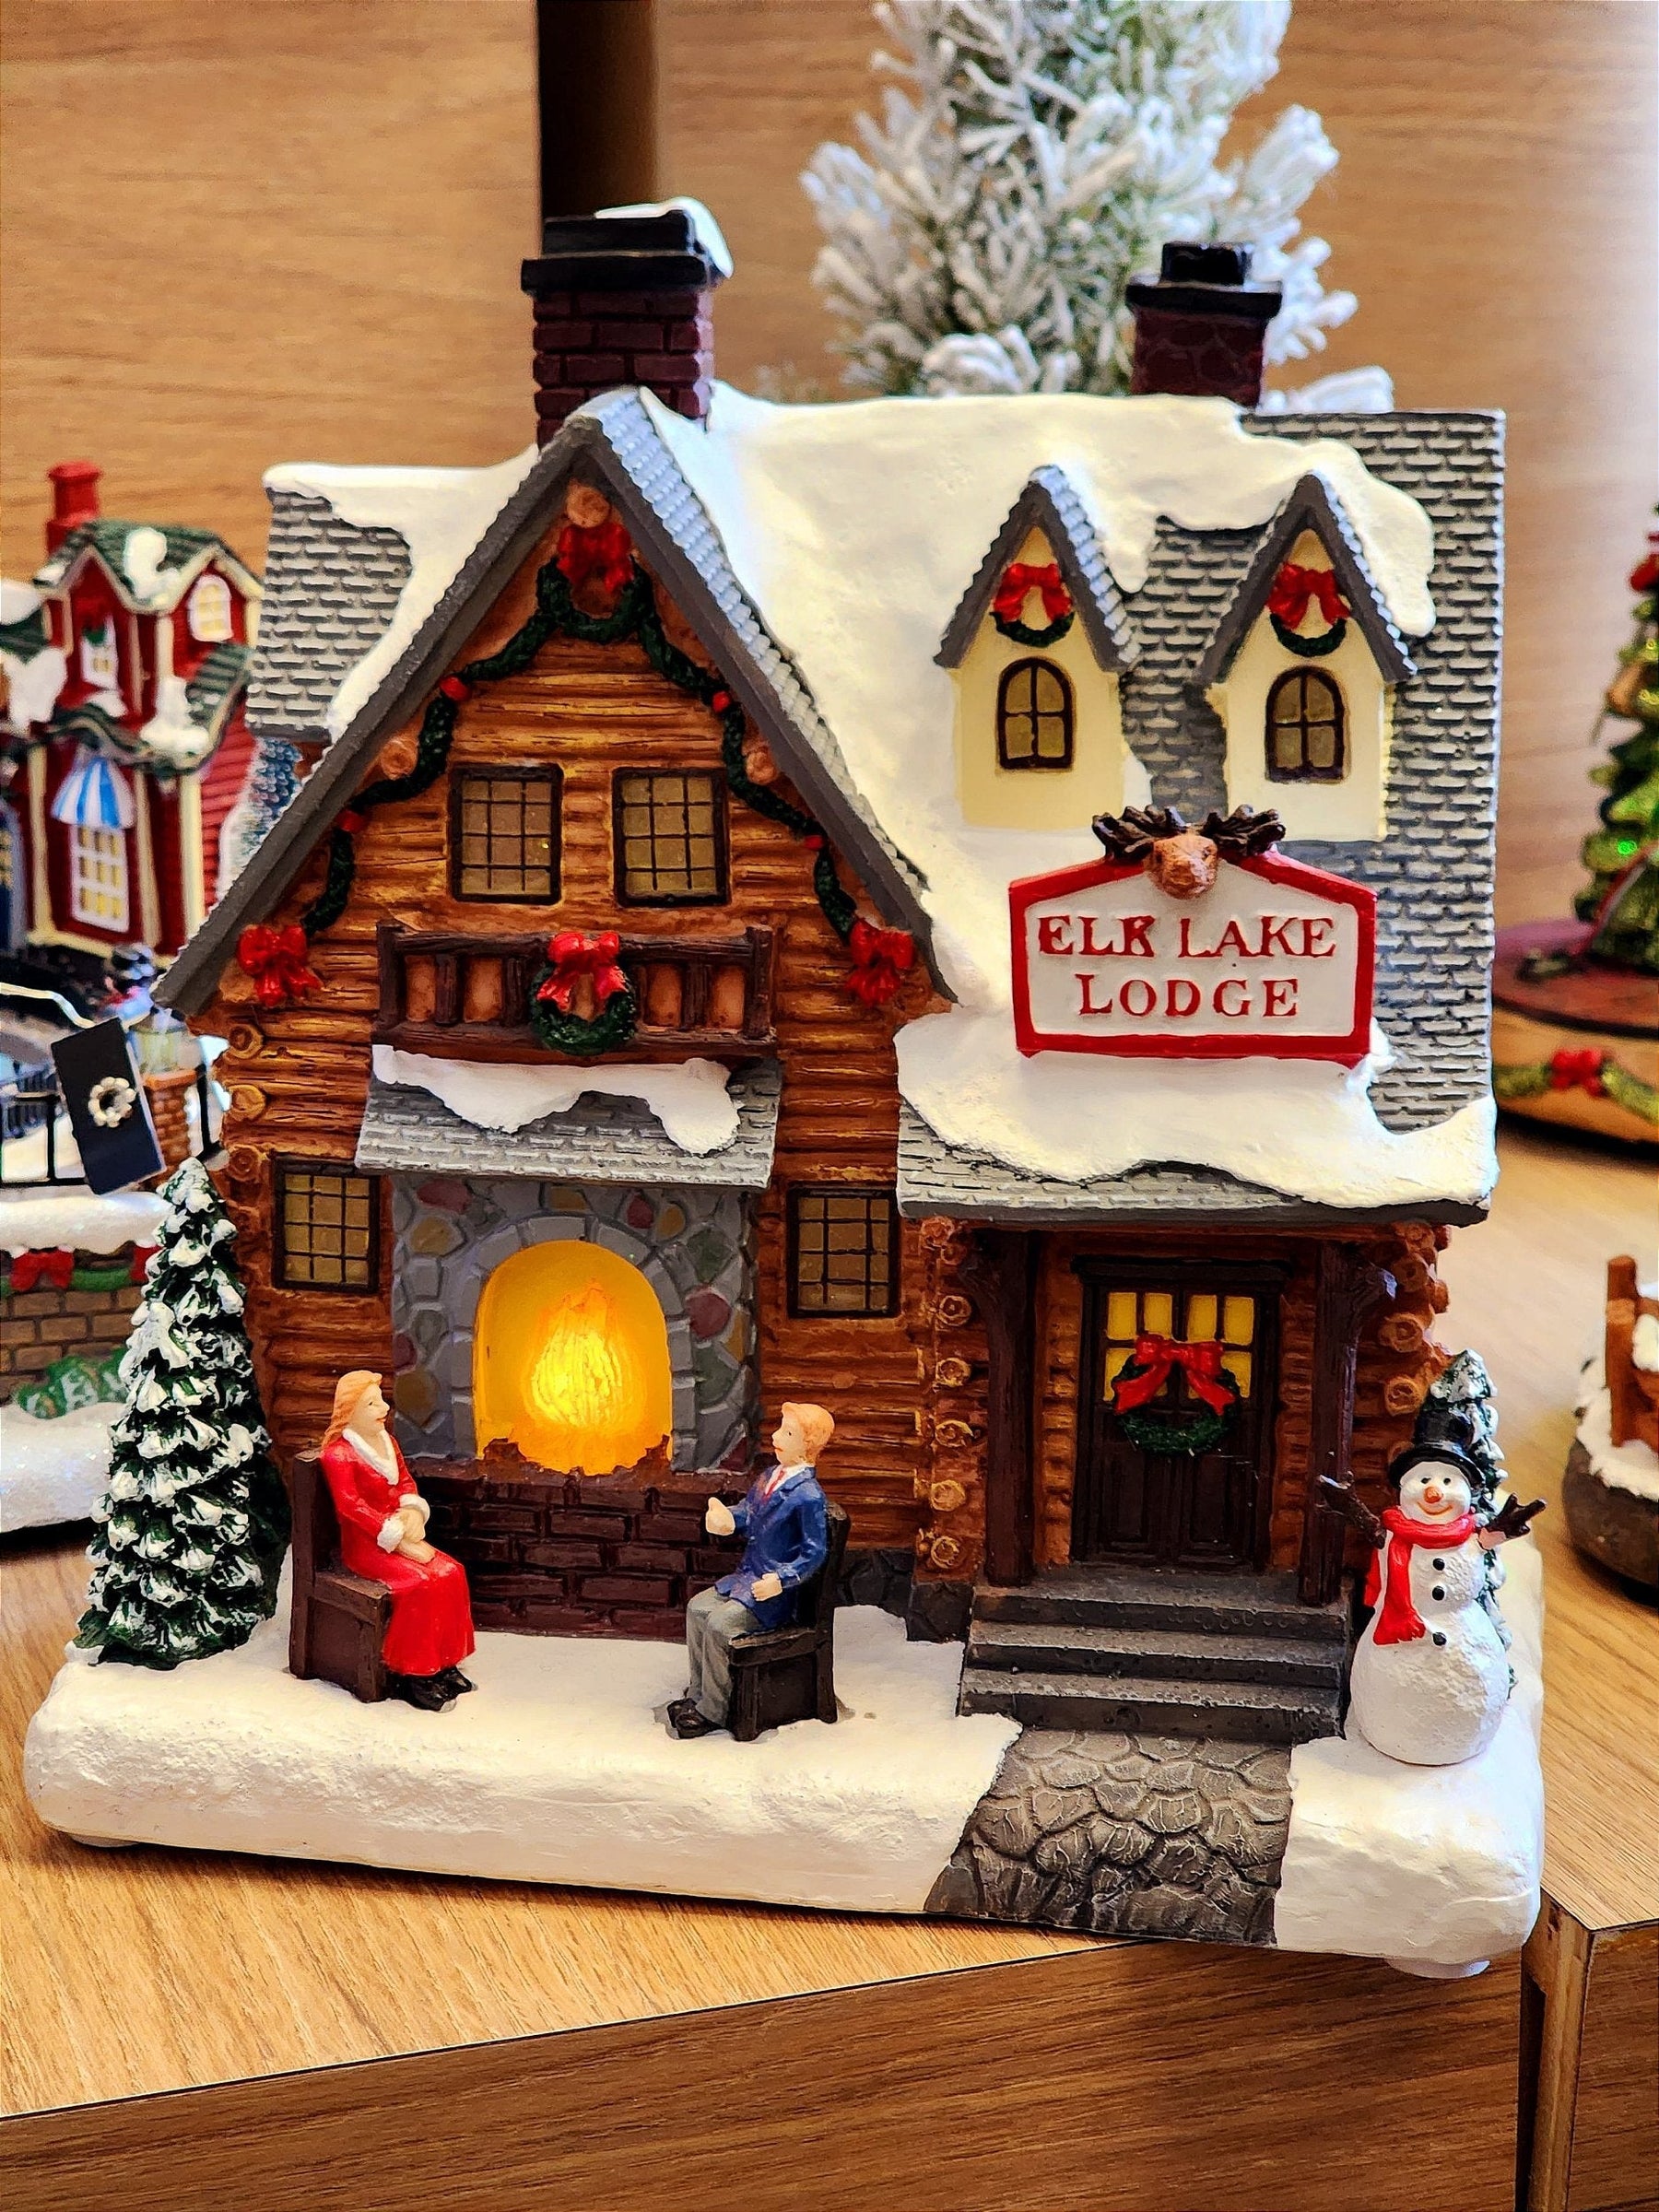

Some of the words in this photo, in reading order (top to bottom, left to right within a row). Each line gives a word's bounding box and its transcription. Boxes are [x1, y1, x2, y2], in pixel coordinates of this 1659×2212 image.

[1038, 914, 1156, 958] ELK
[1178, 915, 1336, 959] LAKE
[1075, 973, 1299, 1018] LODGE
